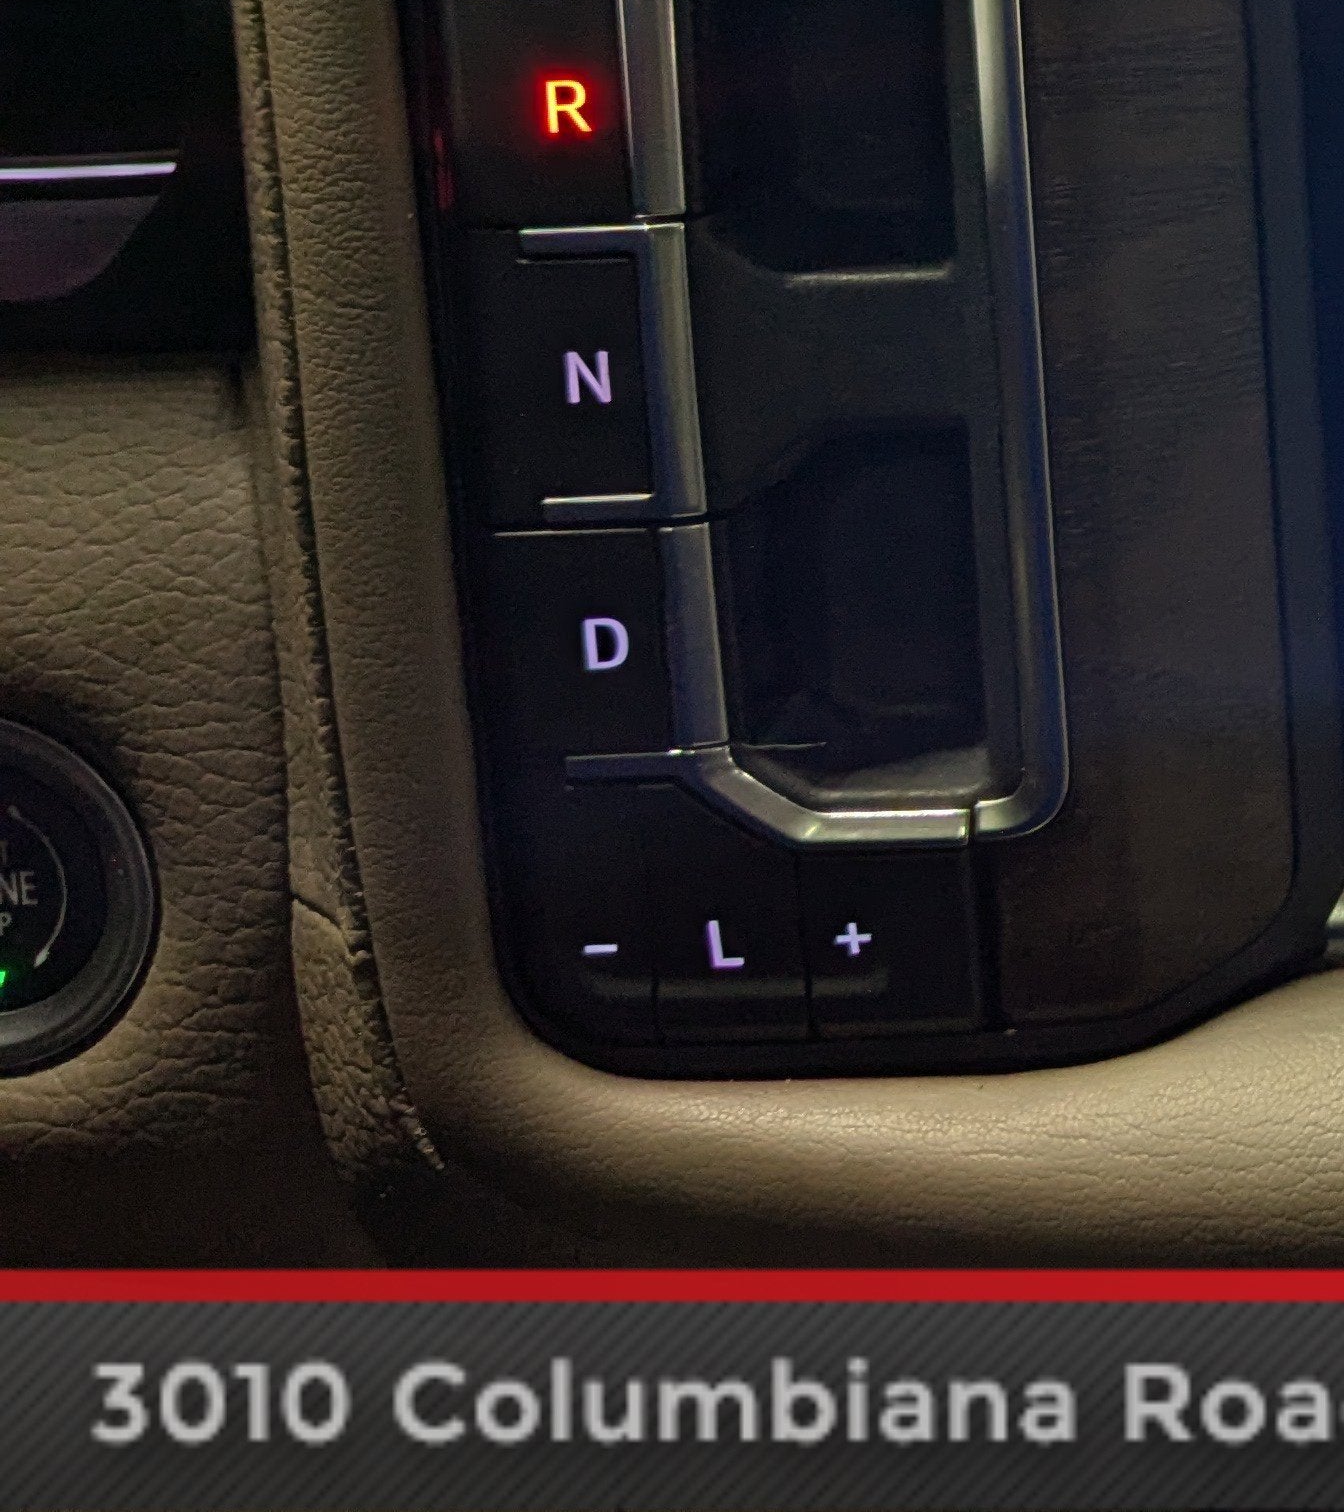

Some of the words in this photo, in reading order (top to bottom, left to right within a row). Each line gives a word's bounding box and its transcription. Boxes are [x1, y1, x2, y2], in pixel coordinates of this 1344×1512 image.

[544, 80, 593, 134] R
[566, 349, 613, 405] N
[582, 616, 630, 671] D
[706, 919, 745, 969] L
